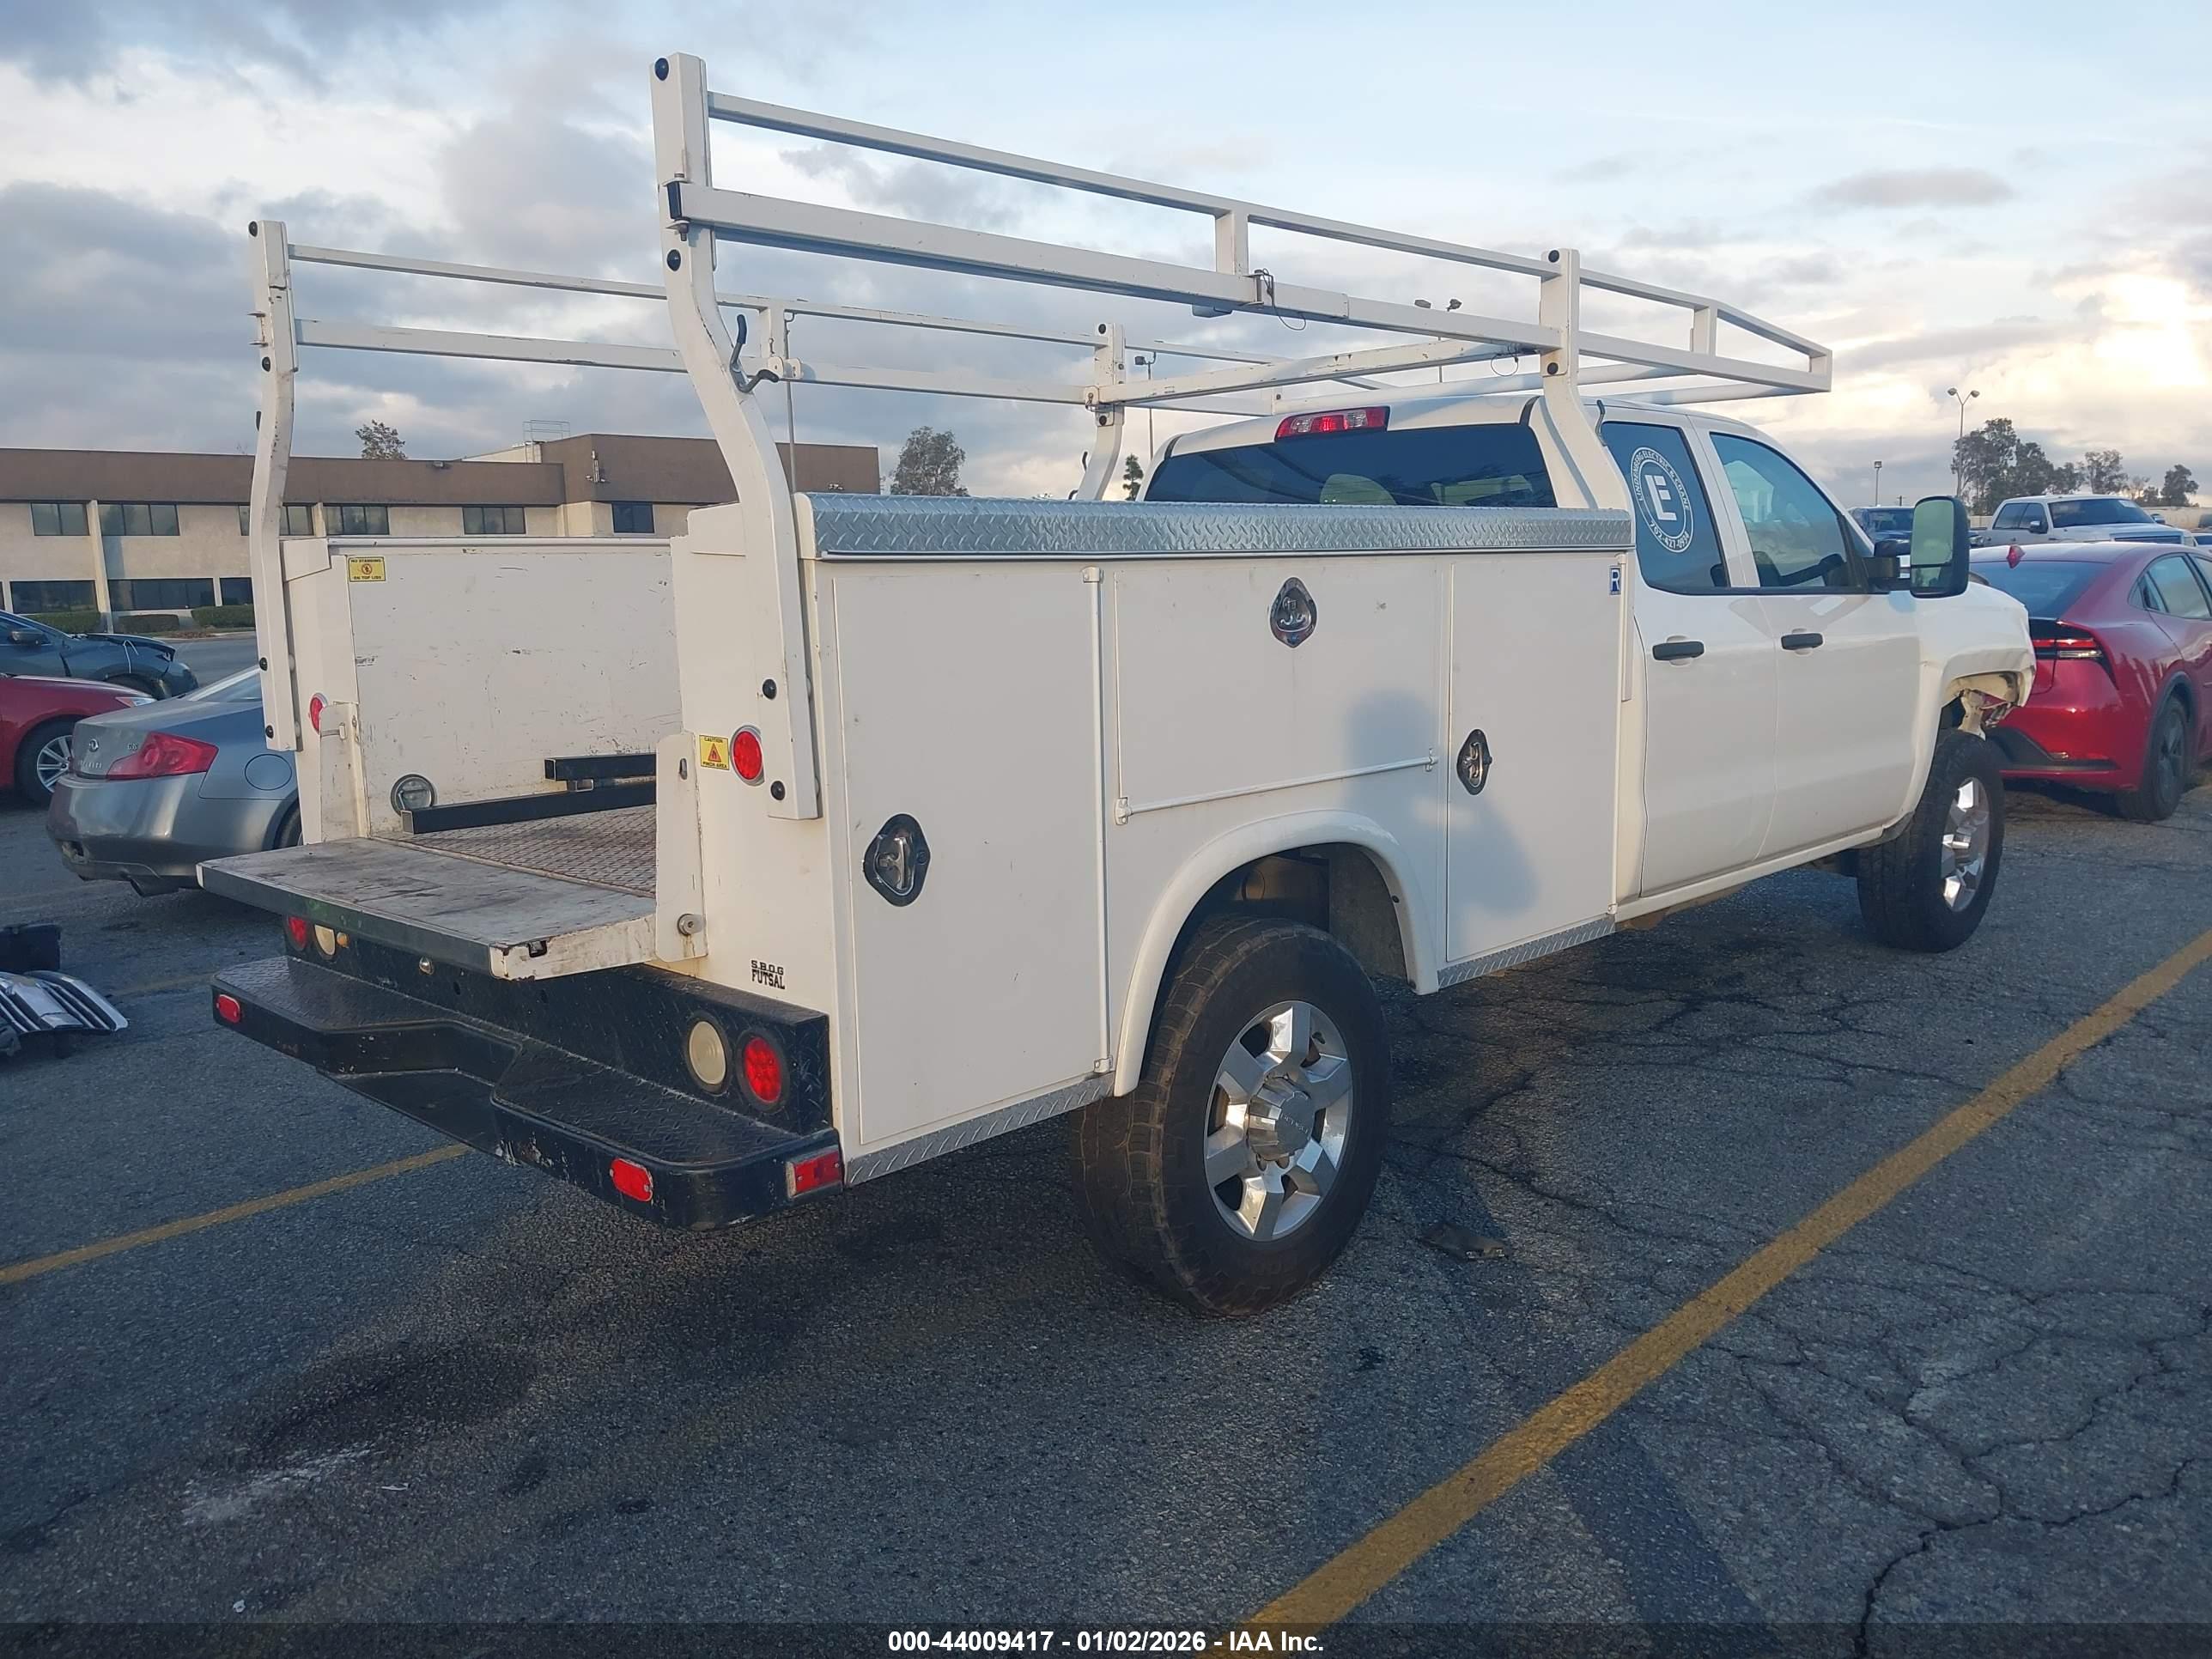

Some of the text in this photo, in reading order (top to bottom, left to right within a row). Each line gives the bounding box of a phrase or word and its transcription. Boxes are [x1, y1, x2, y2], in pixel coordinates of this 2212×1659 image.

[1642, 451, 1669, 471] ELECTRIC
[1674, 479, 1690, 510] CRANE
[1644, 475, 1677, 520] E
[1611, 568, 1621, 591] R
[751, 969, 786, 989] FUTSAL
